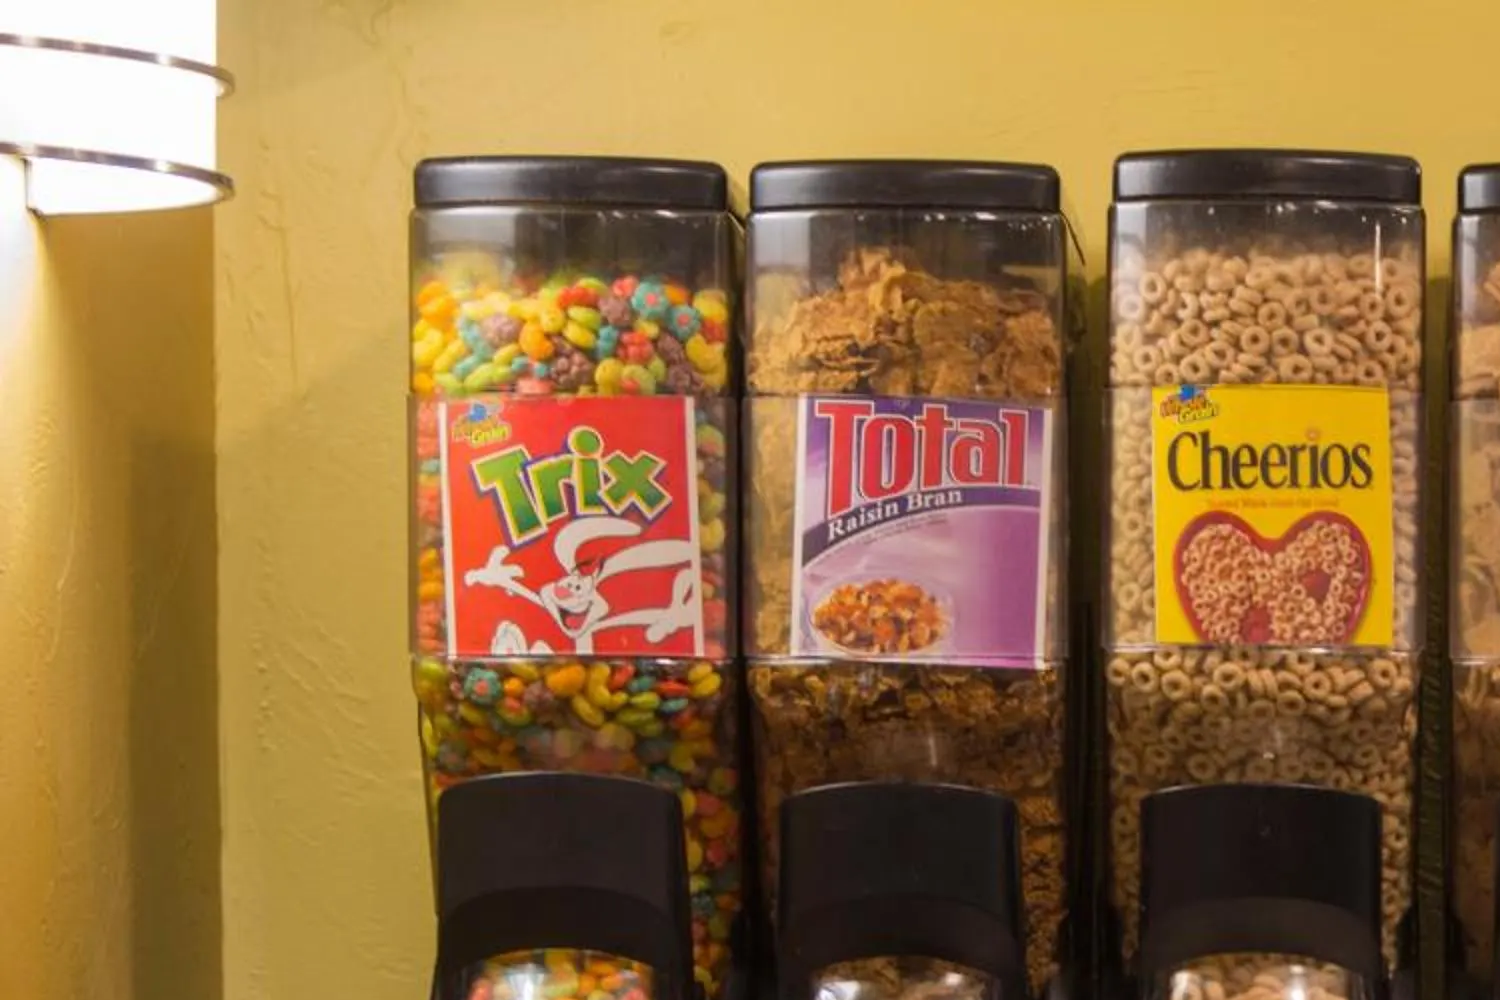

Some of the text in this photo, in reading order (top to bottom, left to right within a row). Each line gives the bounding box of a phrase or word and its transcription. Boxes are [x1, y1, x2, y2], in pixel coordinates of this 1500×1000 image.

[471, 426, 673, 546] Trix
[815, 400, 1030, 519] Total
[1167, 428, 1374, 491] Cheerios
[827, 502, 899, 541] Raisin
[906, 489, 963, 511] Bran
